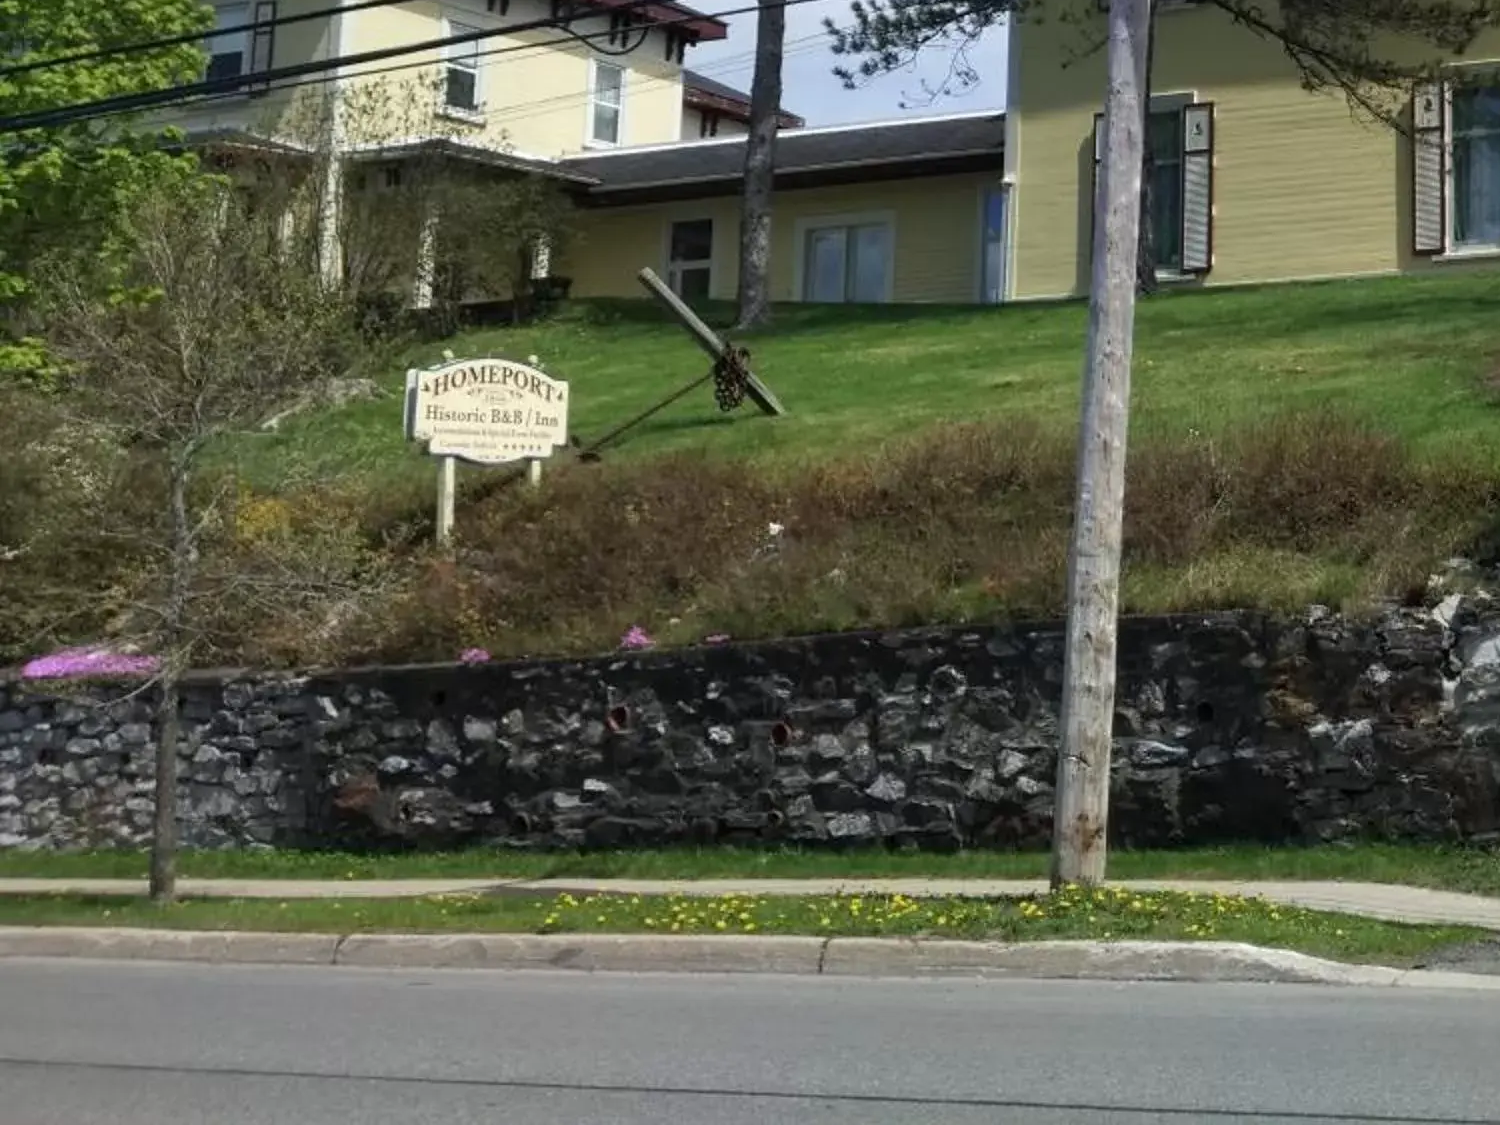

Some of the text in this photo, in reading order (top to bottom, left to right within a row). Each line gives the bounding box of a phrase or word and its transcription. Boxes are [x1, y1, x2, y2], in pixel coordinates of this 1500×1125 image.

[433, 364, 556, 402] HOMEPORT
[425, 404, 487, 424] Historic
[491, 408, 523, 425] B&B
[535, 410, 559, 427] Inn
